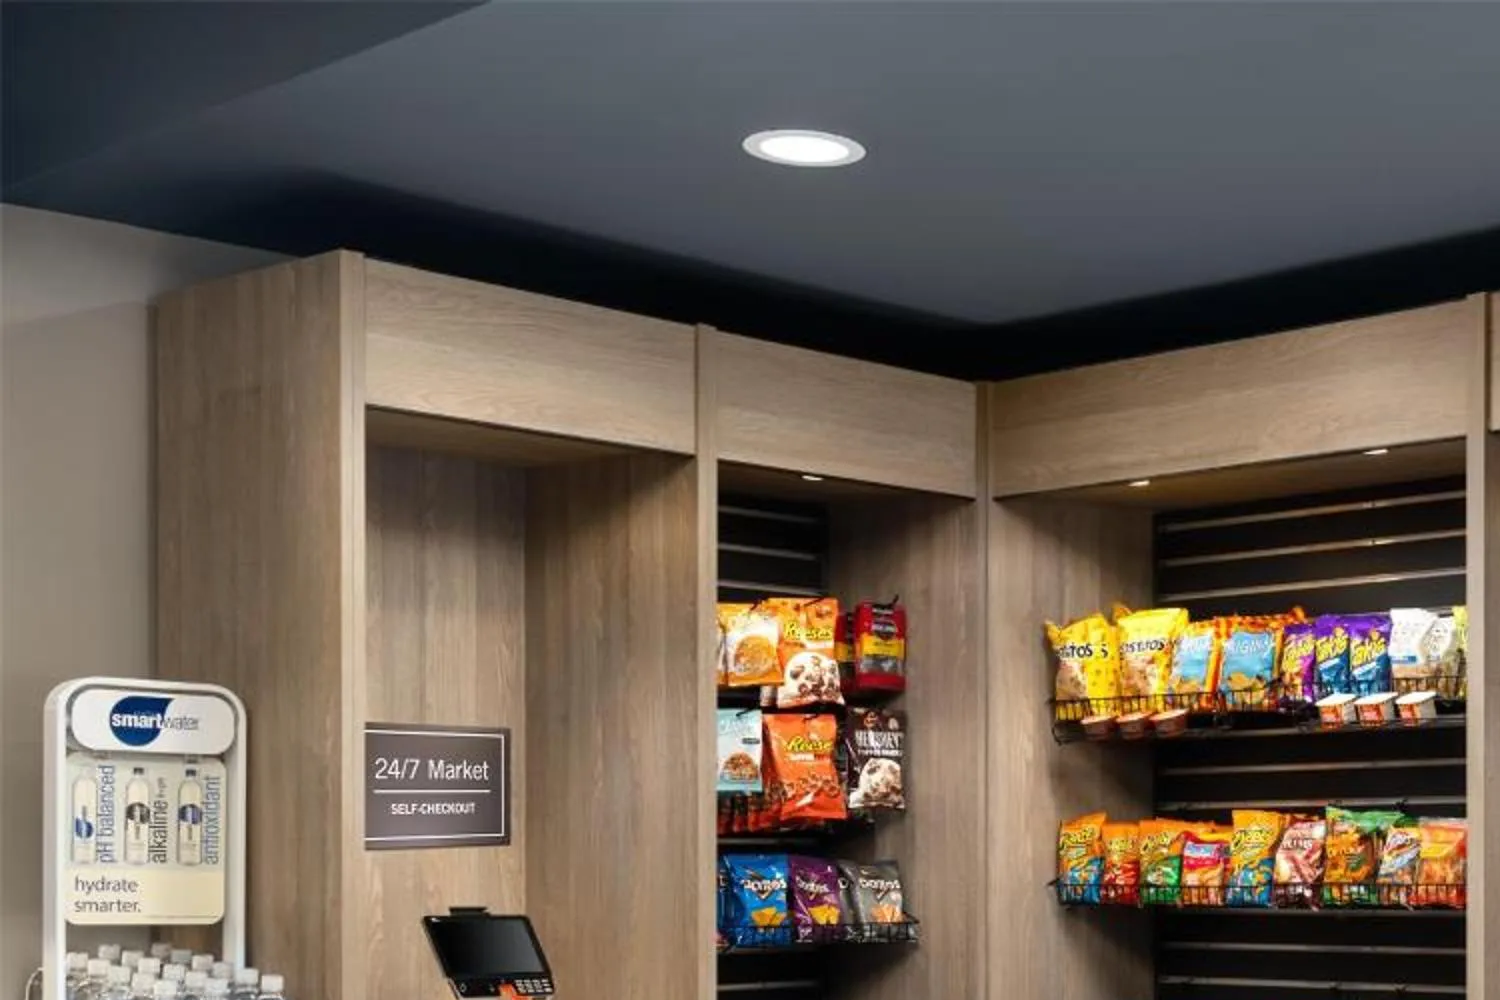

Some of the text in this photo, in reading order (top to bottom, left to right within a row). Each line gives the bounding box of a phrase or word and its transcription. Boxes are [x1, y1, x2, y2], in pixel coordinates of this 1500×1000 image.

[374, 757, 490, 781] 24/7 Market
[99, 764, 116, 838] balanced
[391, 802, 476, 815] SELF-CHECKOUT
[151, 801, 168, 864] alkaline
[74, 876, 139, 896] hydrate
[74, 899, 142, 913] smarter.
